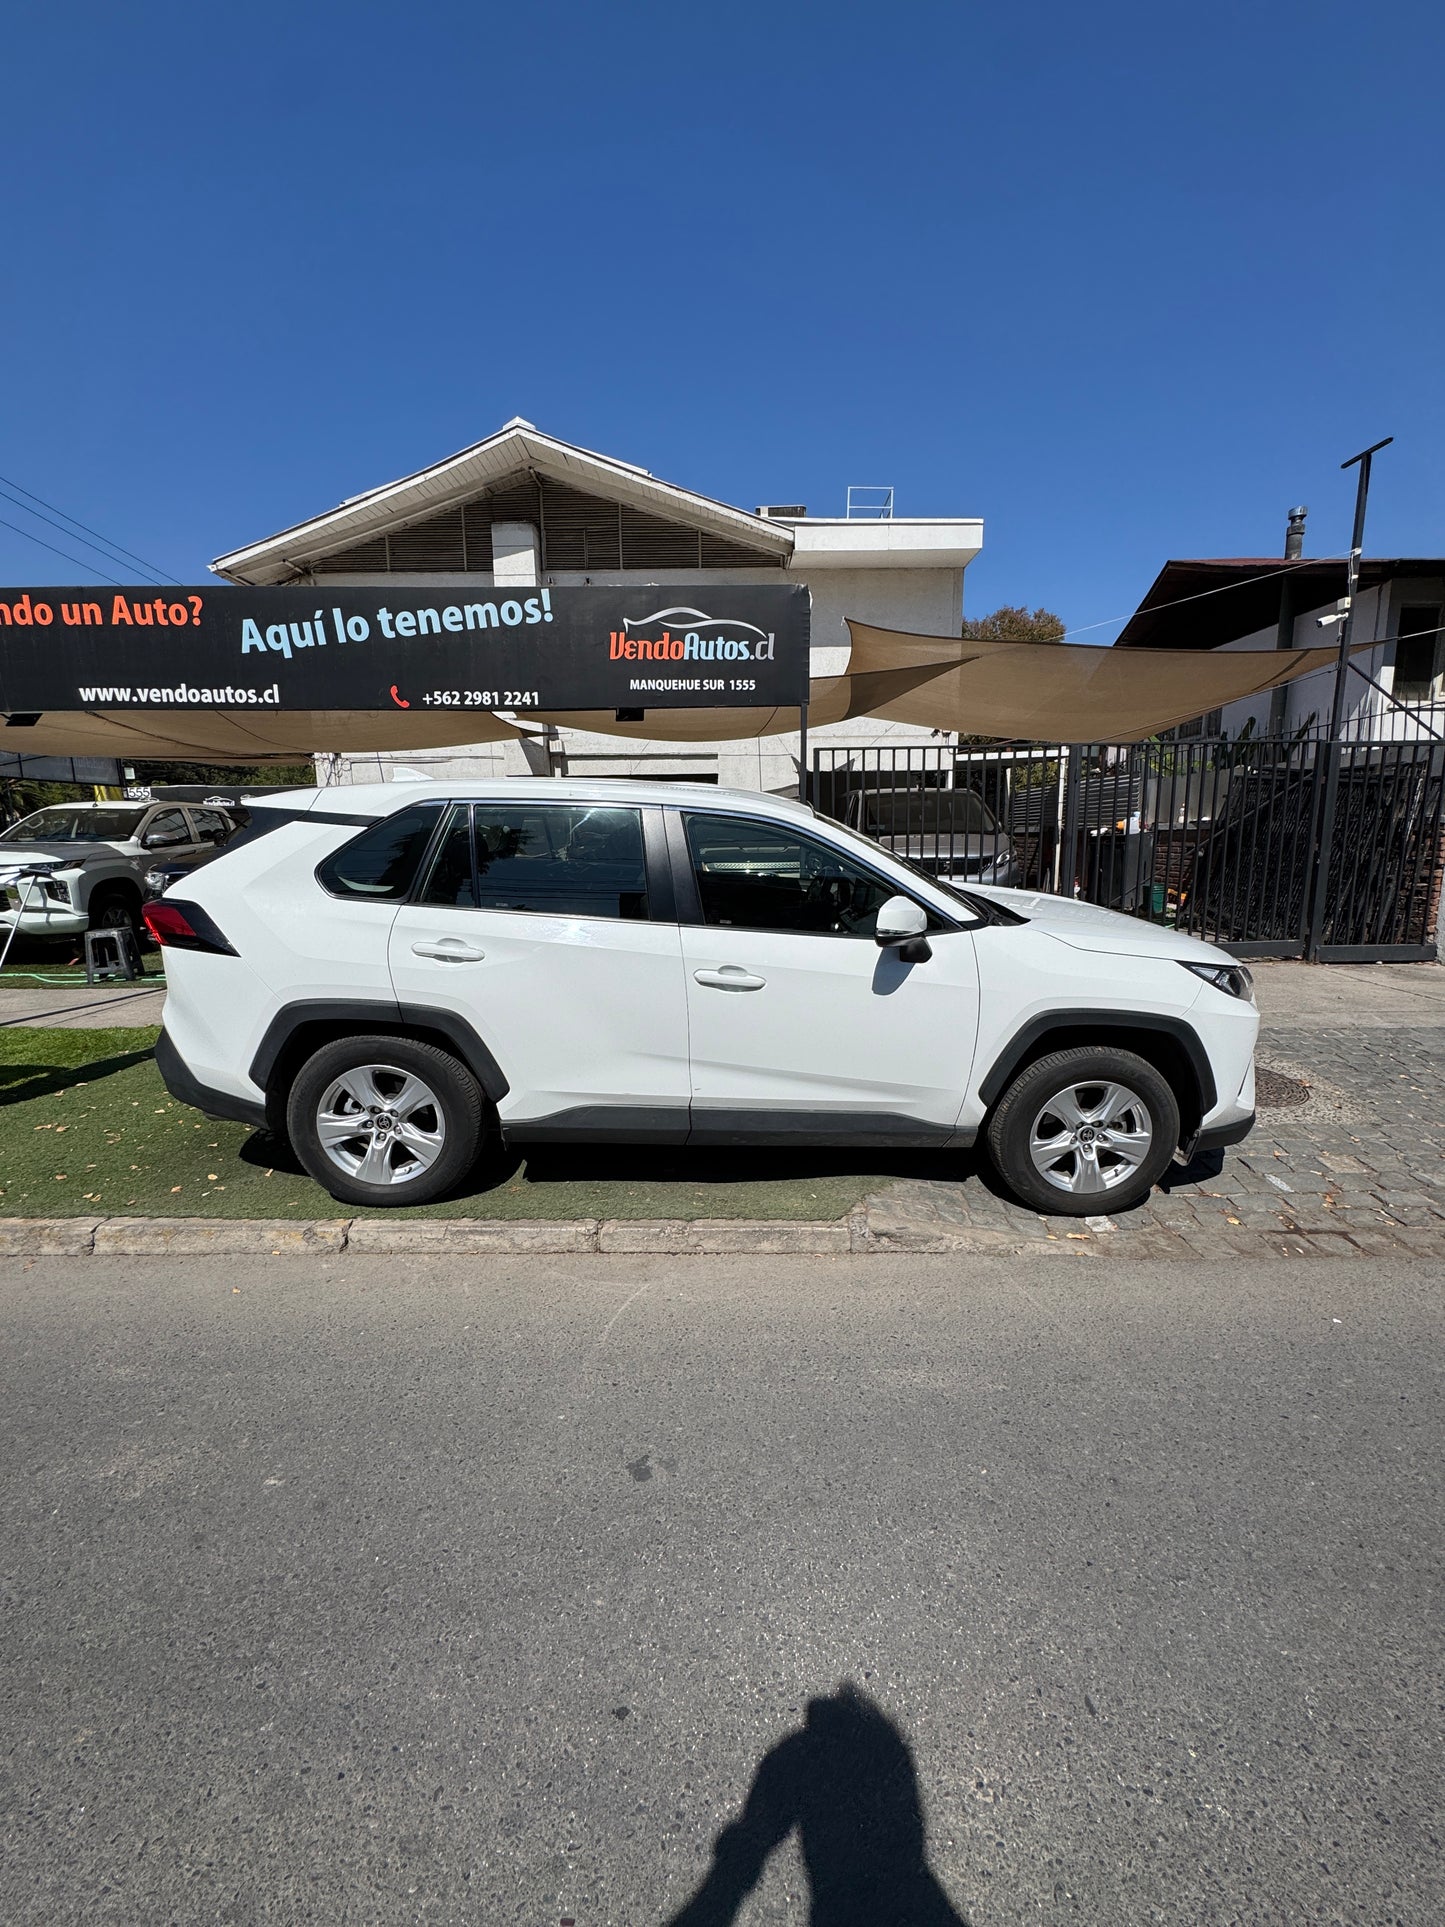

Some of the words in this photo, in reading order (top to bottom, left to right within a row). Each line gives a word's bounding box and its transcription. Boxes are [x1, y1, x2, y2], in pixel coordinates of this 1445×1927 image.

[61, 603, 103, 625] un
[111, 595, 203, 627] Auto?
[241, 610, 327, 659] Aquí
[332, 607, 370, 643] lo
[377, 589, 554, 639] tenemos!
[609, 632, 775, 661] VendoAutos.cl
[79, 684, 280, 704] www.vendoautos.cl
[630, 679, 701, 692] MANQUEHUE
[702, 679, 725, 691] SUR
[729, 679, 756, 691] 1555
[422, 691, 460, 706] +562
[463, 691, 500, 706] 2981
[503, 691, 539, 706] 2241
